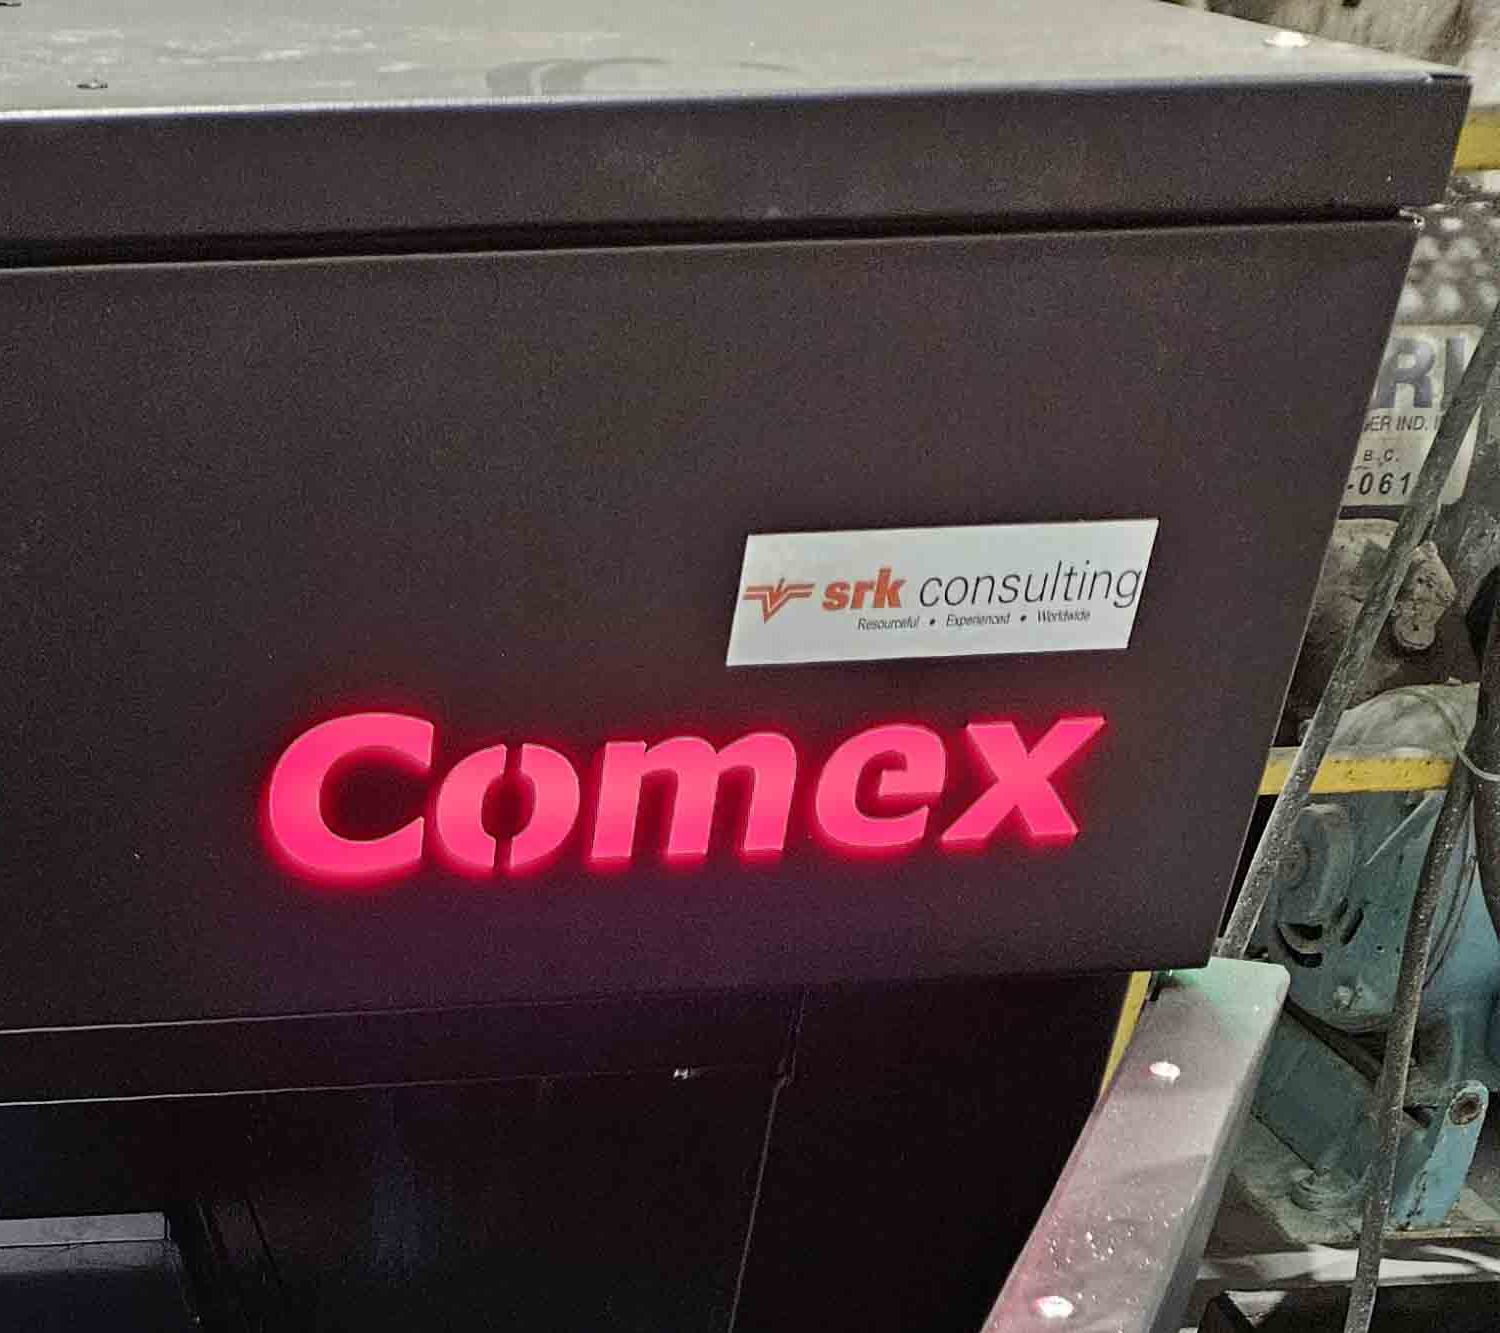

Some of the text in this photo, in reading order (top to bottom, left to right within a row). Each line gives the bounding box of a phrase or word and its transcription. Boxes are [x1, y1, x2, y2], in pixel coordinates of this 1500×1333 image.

[1396, 415, 1428, 431] IND.
[822, 560, 1143, 611] srk consulting
[858, 610, 1091, 630] Resourceful Experienced Worldwide
[269, 712, 1106, 872] Comex
